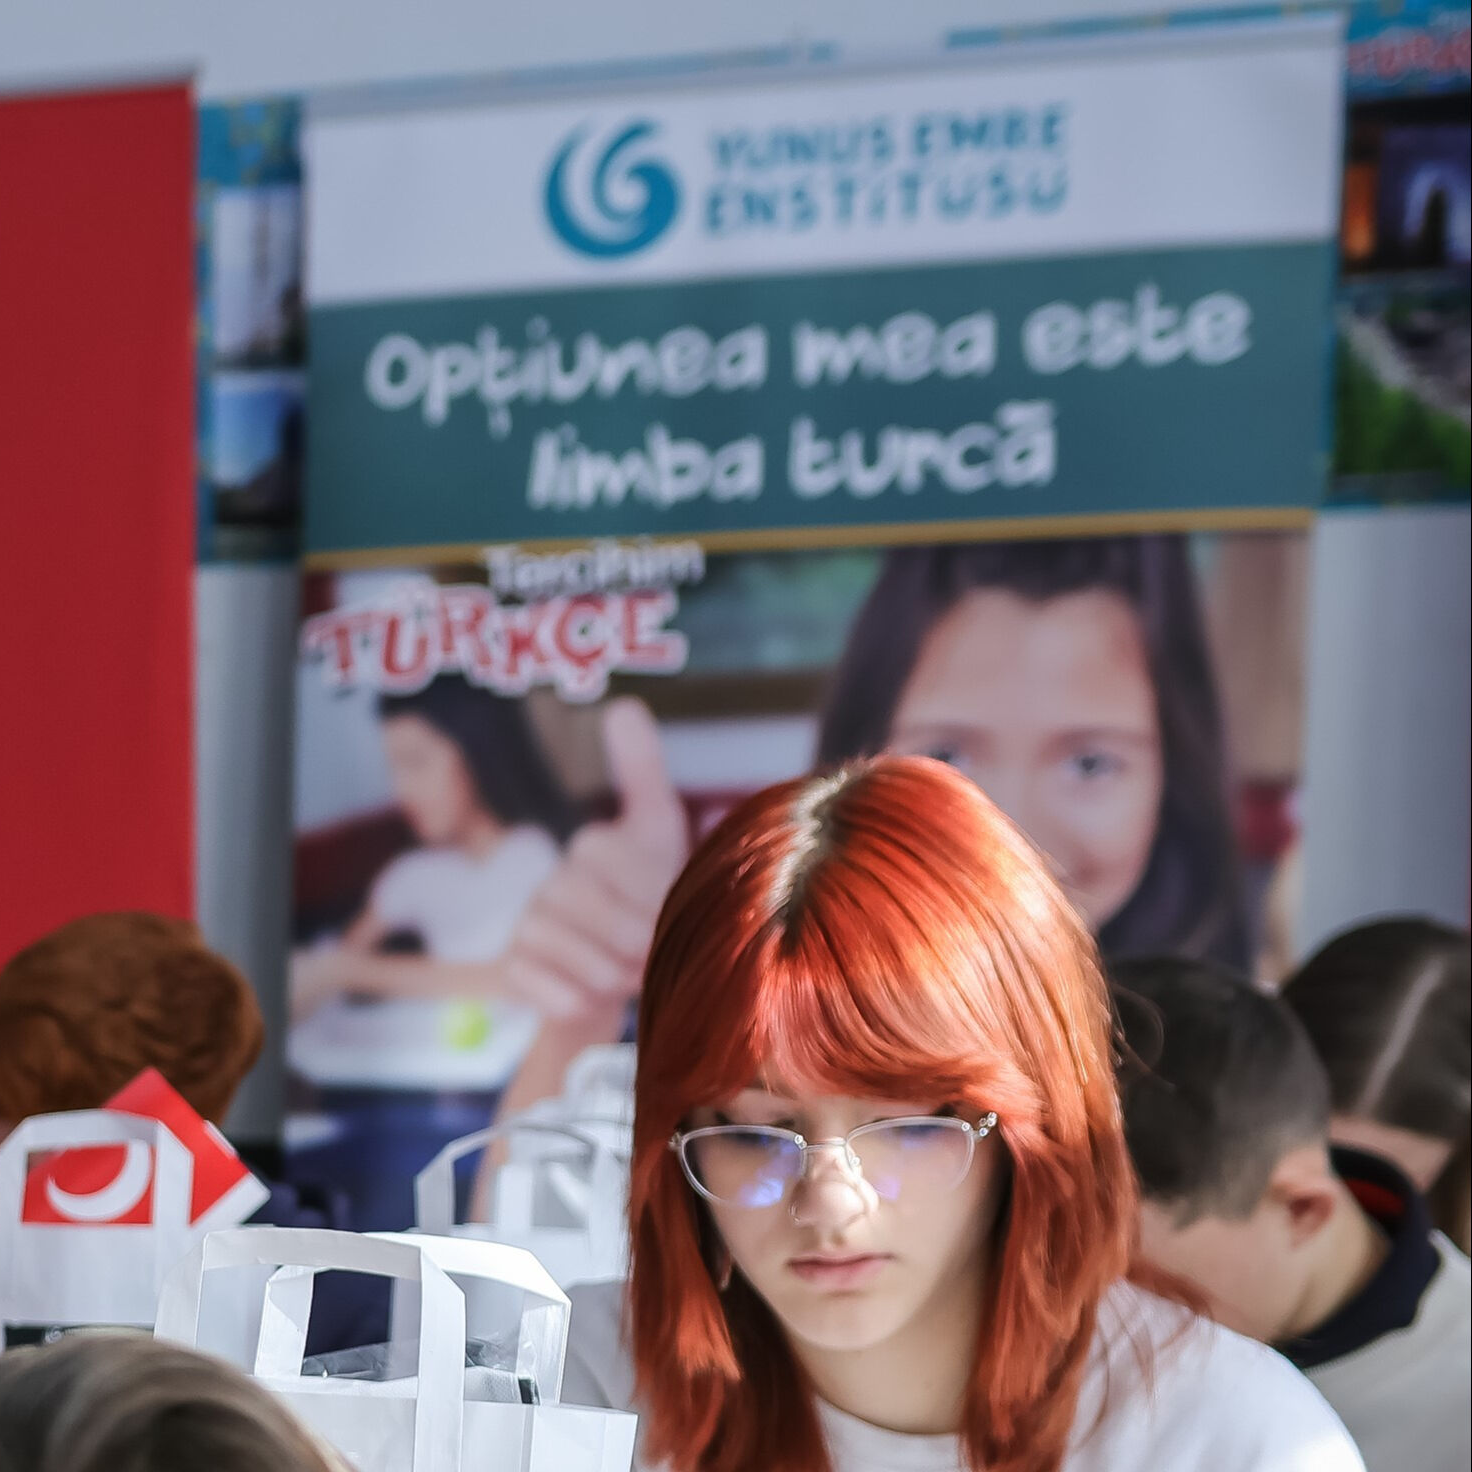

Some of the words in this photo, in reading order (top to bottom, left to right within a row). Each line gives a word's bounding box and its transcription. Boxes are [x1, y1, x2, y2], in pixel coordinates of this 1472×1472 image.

[791, 308, 998, 386] mea
[1021, 282, 1253, 374] este
[526, 421, 765, 510] limba
